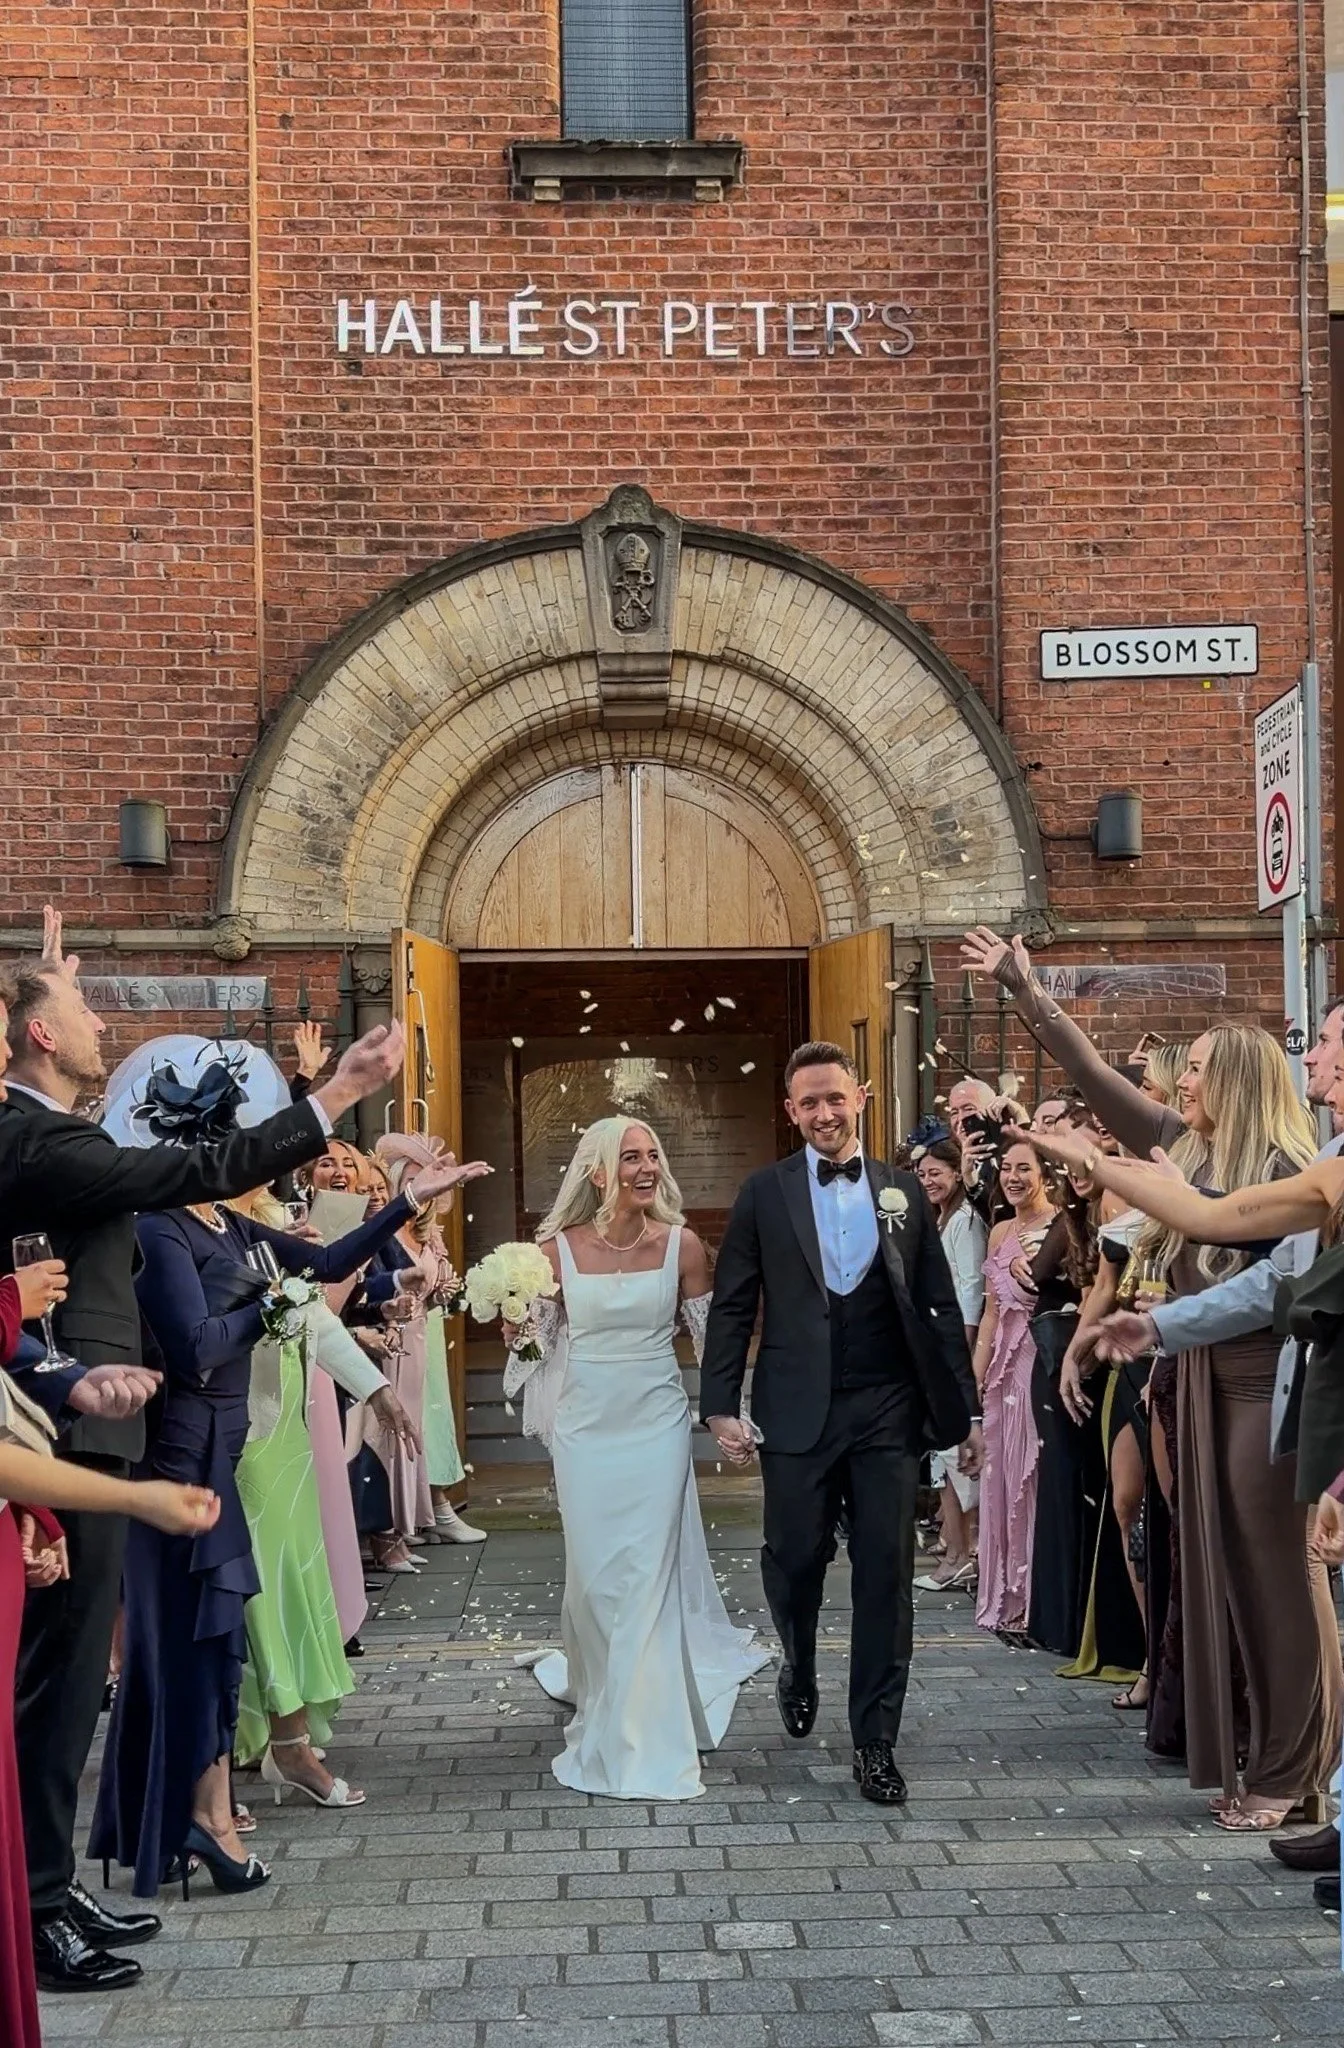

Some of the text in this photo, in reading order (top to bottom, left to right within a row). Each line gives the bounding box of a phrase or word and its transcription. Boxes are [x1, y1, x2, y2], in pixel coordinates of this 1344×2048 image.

[336, 285, 914, 357] HALLÉ ST PETER'S
[1056, 638, 1249, 667] BLOSSOM ST.
[1257, 699, 1296, 740] PEDESTRIAN
[1260, 721, 1292, 757] and CYCLE
[1263, 749, 1291, 790] ZONE
